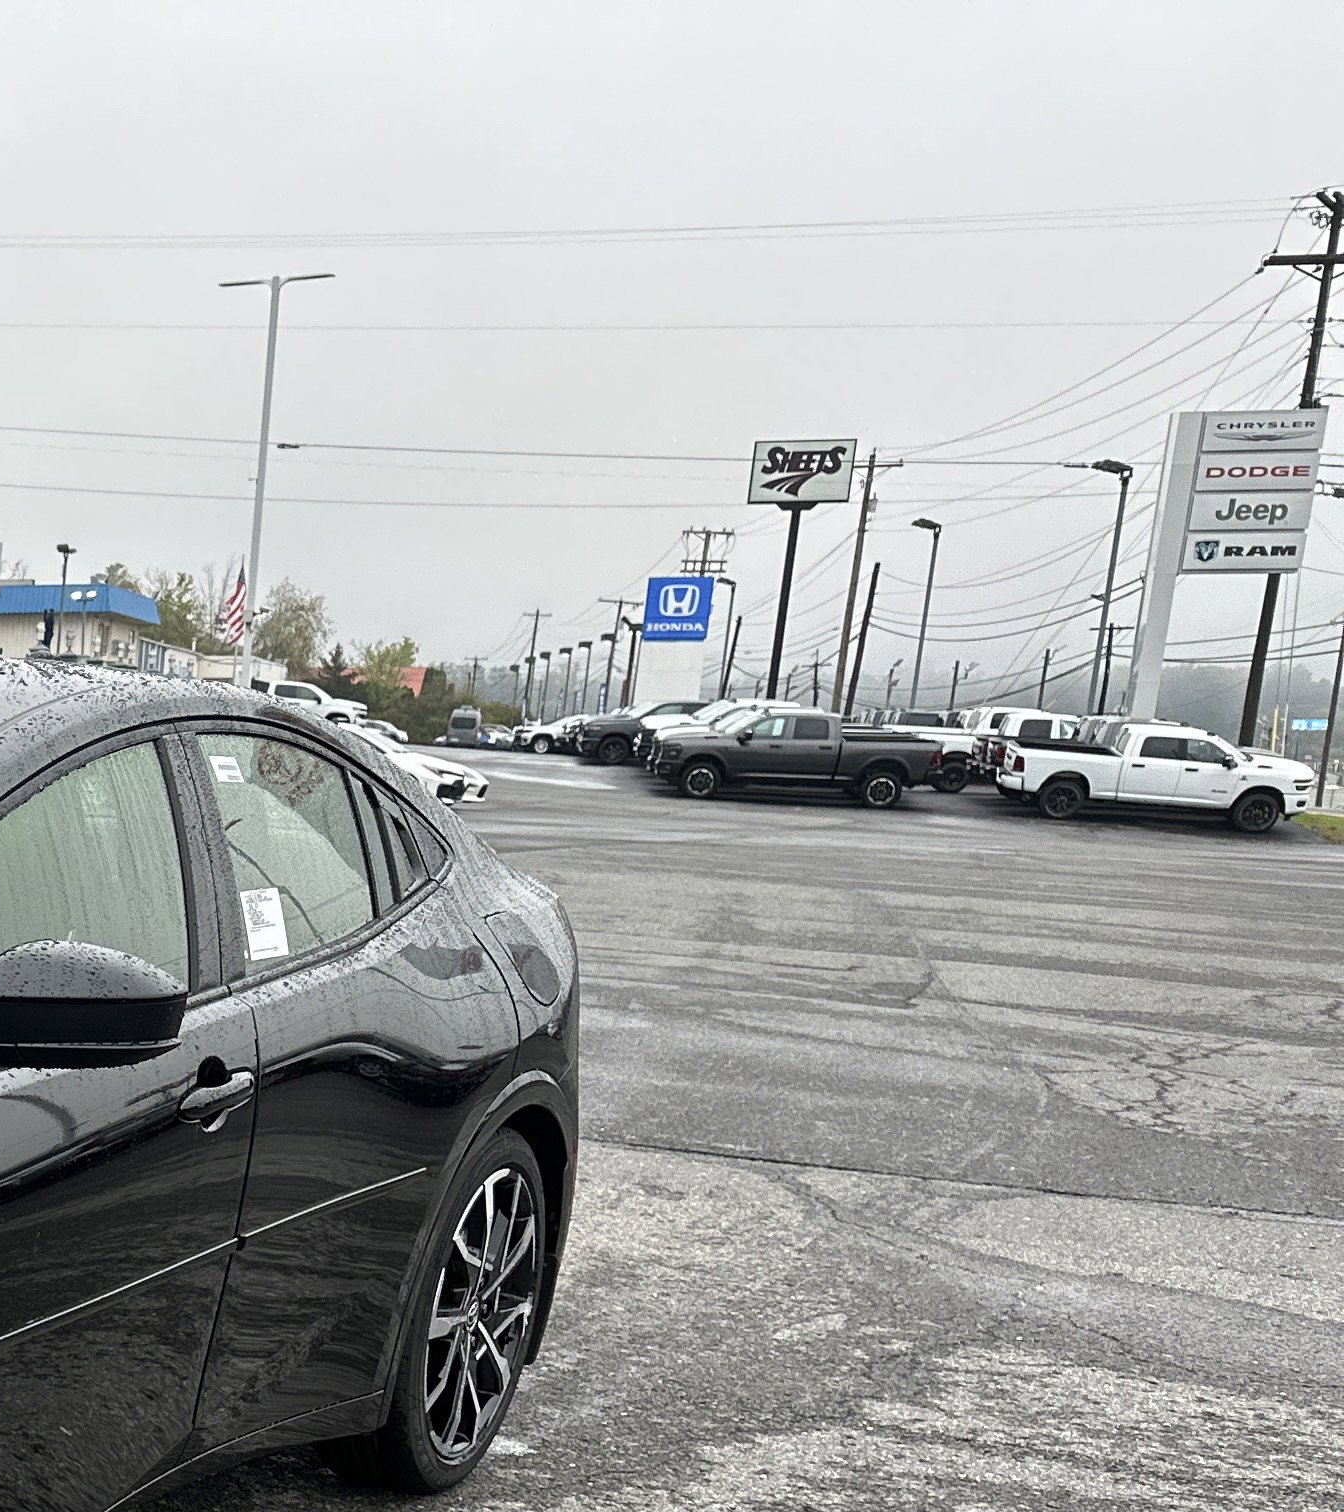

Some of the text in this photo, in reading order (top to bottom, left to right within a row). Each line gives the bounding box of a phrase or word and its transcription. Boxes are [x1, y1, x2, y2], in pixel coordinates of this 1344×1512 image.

[1216, 421, 1316, 430] CHRYSLER
[1205, 465, 1311, 479] DODGE
[1215, 498, 1289, 525] Jeep
[1223, 545, 1297, 557] RAM
[646, 622, 705, 632] HONDA
